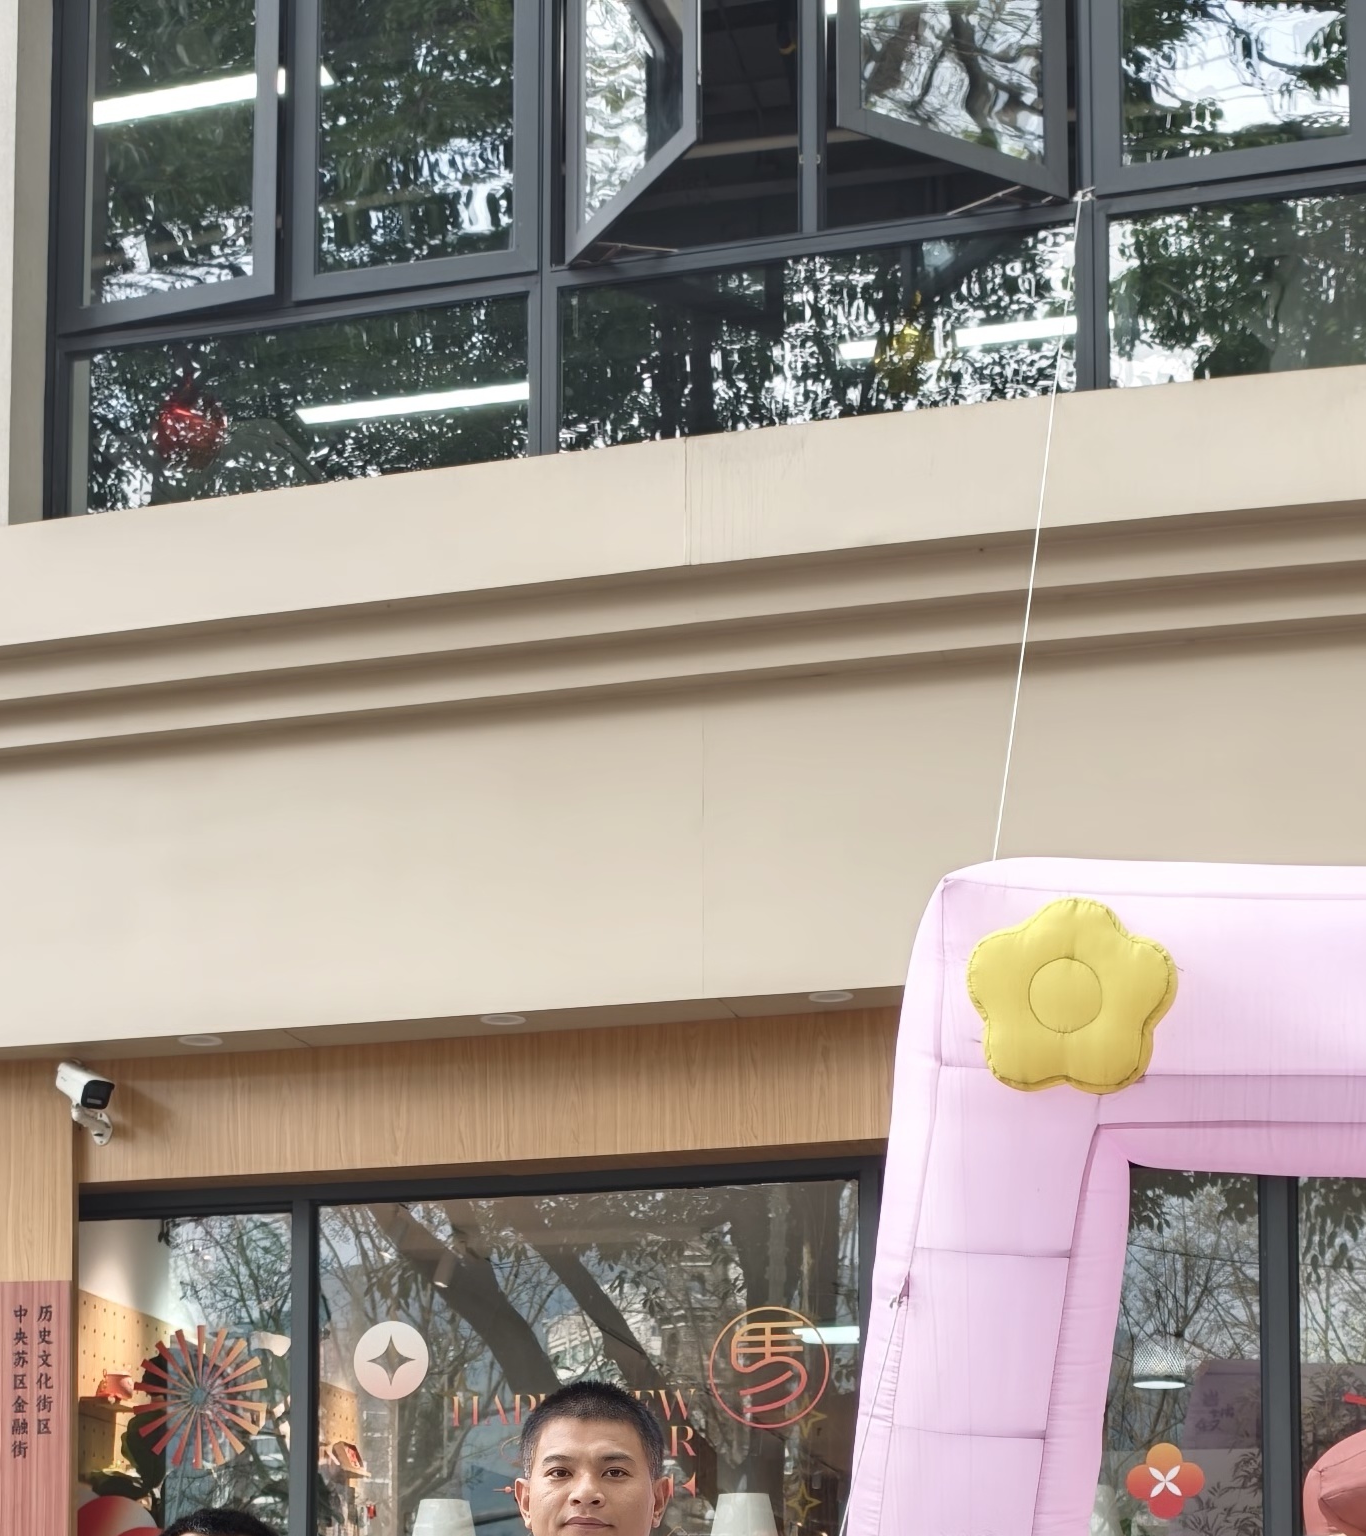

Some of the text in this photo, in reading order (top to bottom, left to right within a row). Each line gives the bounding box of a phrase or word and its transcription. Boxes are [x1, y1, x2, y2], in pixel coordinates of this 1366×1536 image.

[10, 1304, 29, 1460] 中央苏区金融街
[35, 1303, 54, 1436] 历史文化街区
